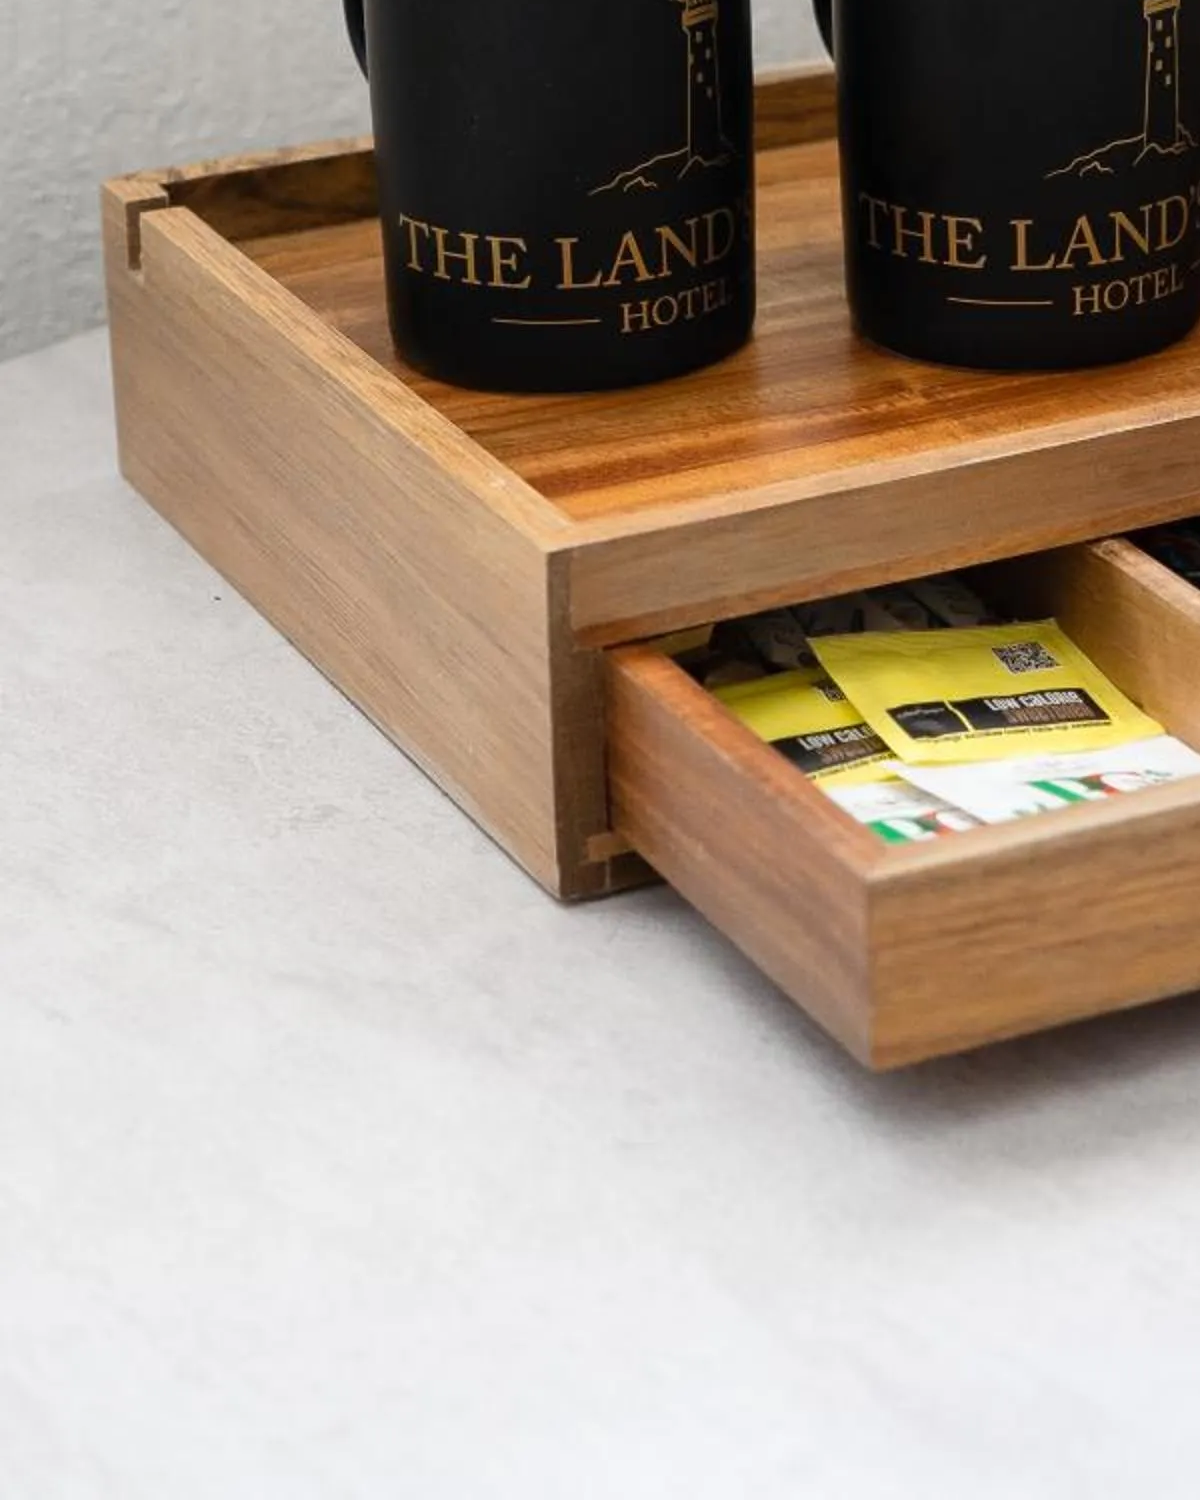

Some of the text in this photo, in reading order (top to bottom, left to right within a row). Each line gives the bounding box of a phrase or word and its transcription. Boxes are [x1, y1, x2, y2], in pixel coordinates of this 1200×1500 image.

[400, 212, 532, 290] THE
[858, 191, 988, 270] THE
[620, 278, 733, 334] HOTEL
[1071, 263, 1184, 316] HOTEL
